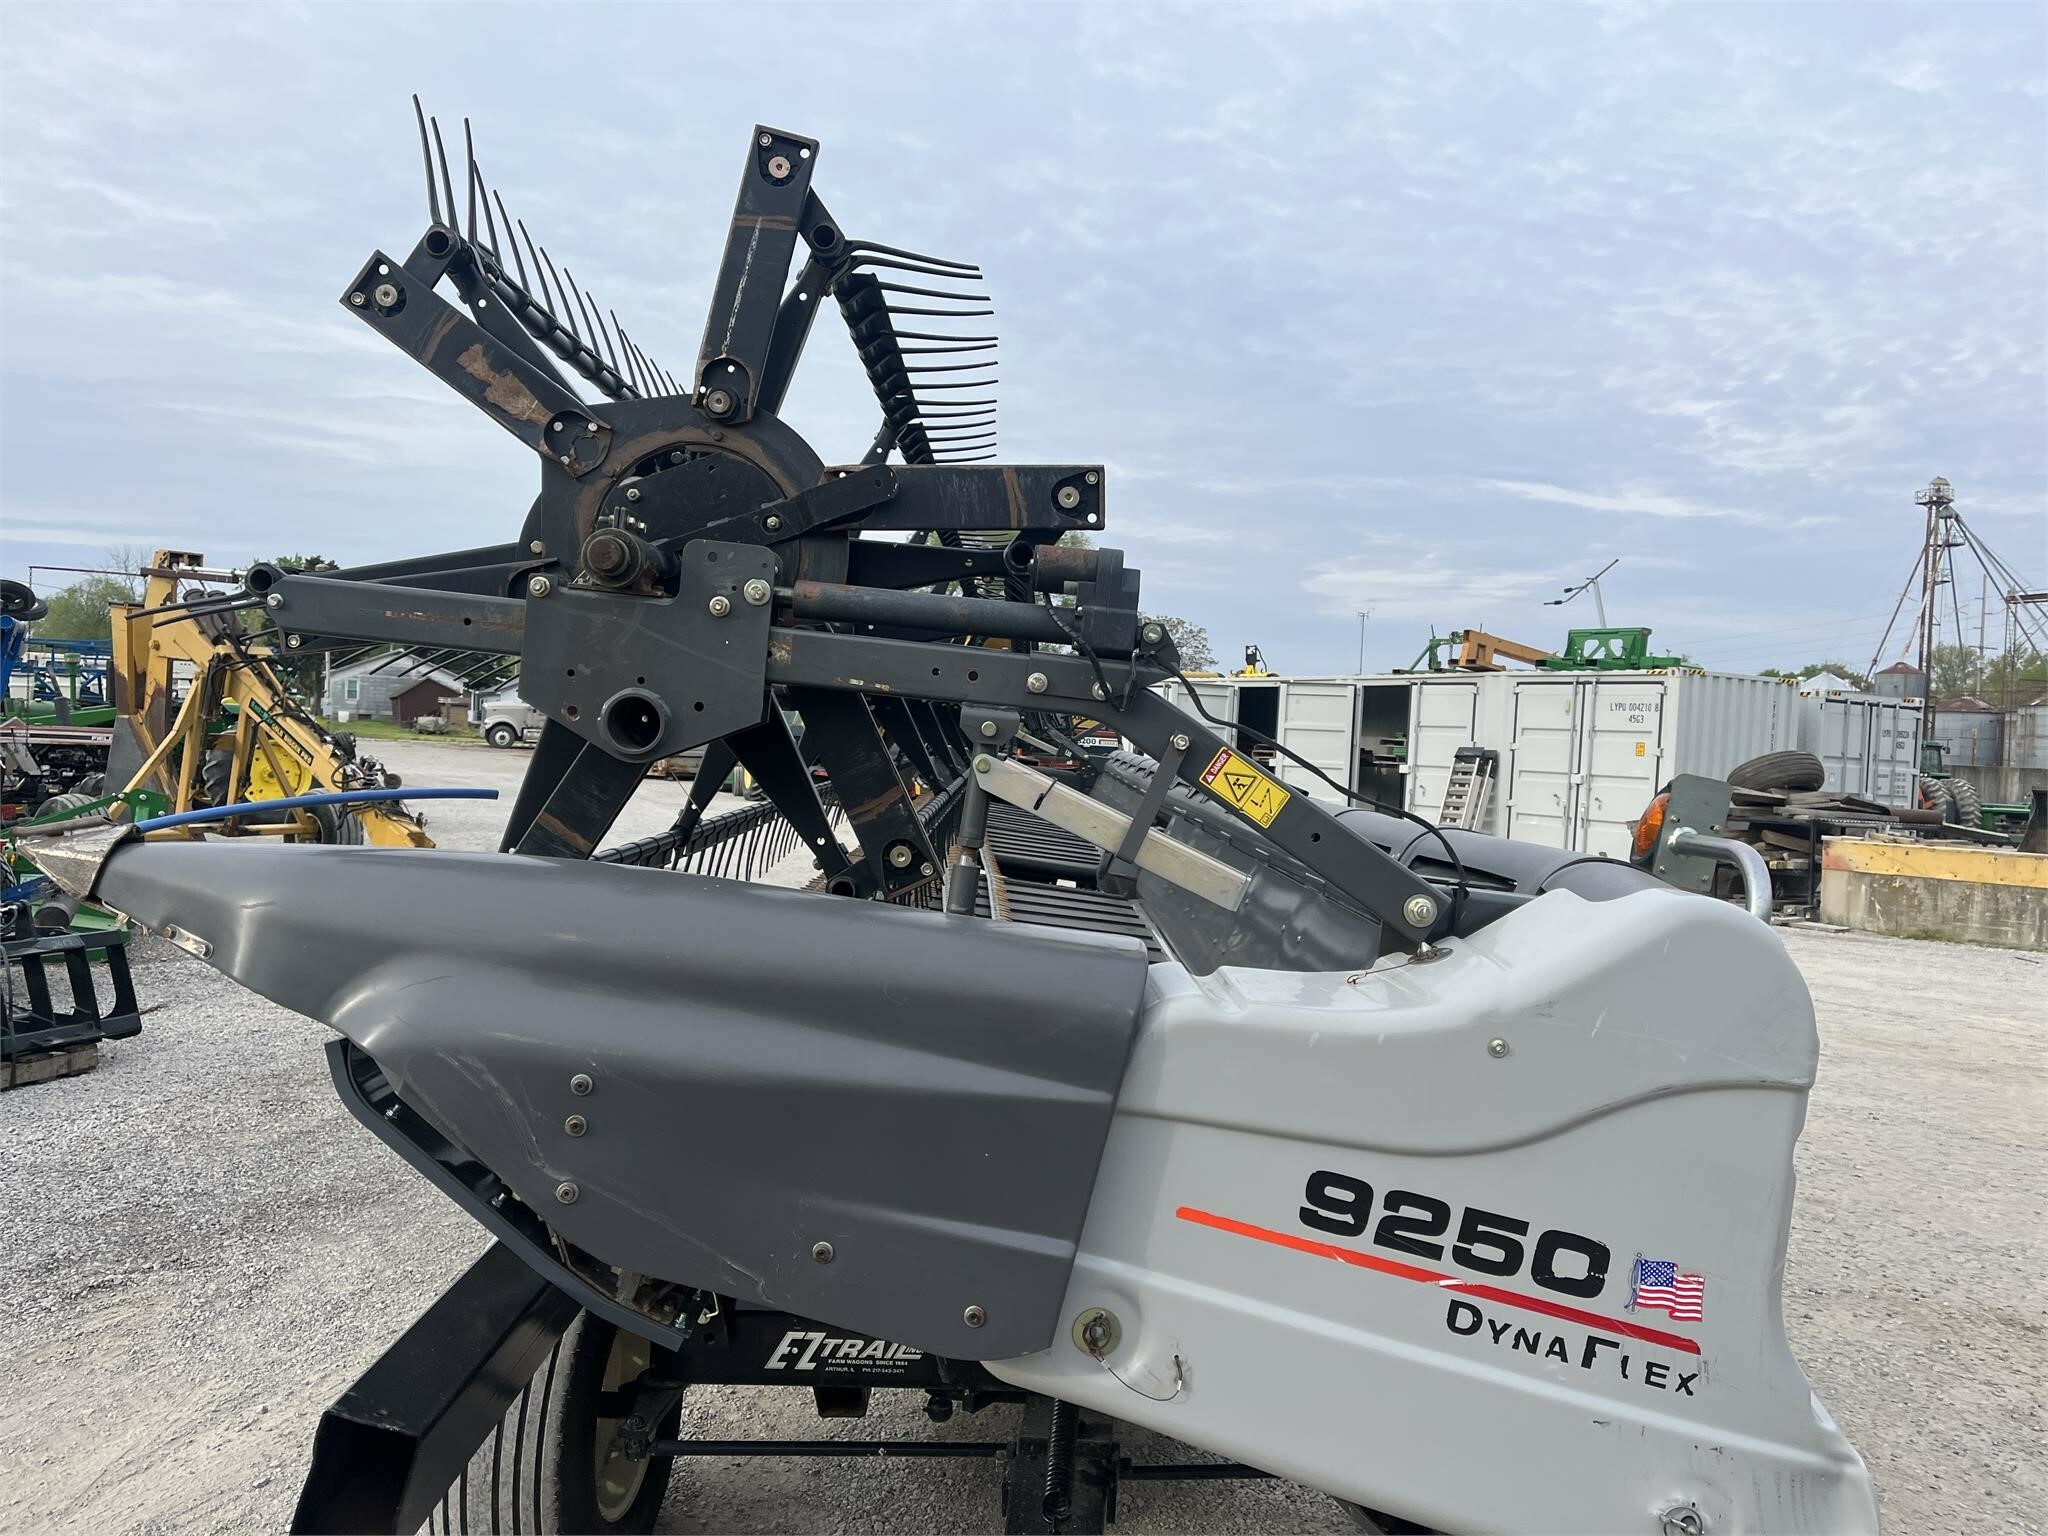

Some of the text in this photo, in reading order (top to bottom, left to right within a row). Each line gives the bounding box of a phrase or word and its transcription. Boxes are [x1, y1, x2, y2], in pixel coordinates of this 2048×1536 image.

[1610, 702, 1660, 713] LYPU 004210 8
[1628, 714, 1645, 724] 45G3
[1210, 753, 1229, 774] DANGER
[1298, 1169, 1611, 1299] 9250
[820, 1338, 923, 1360] TRAIL
